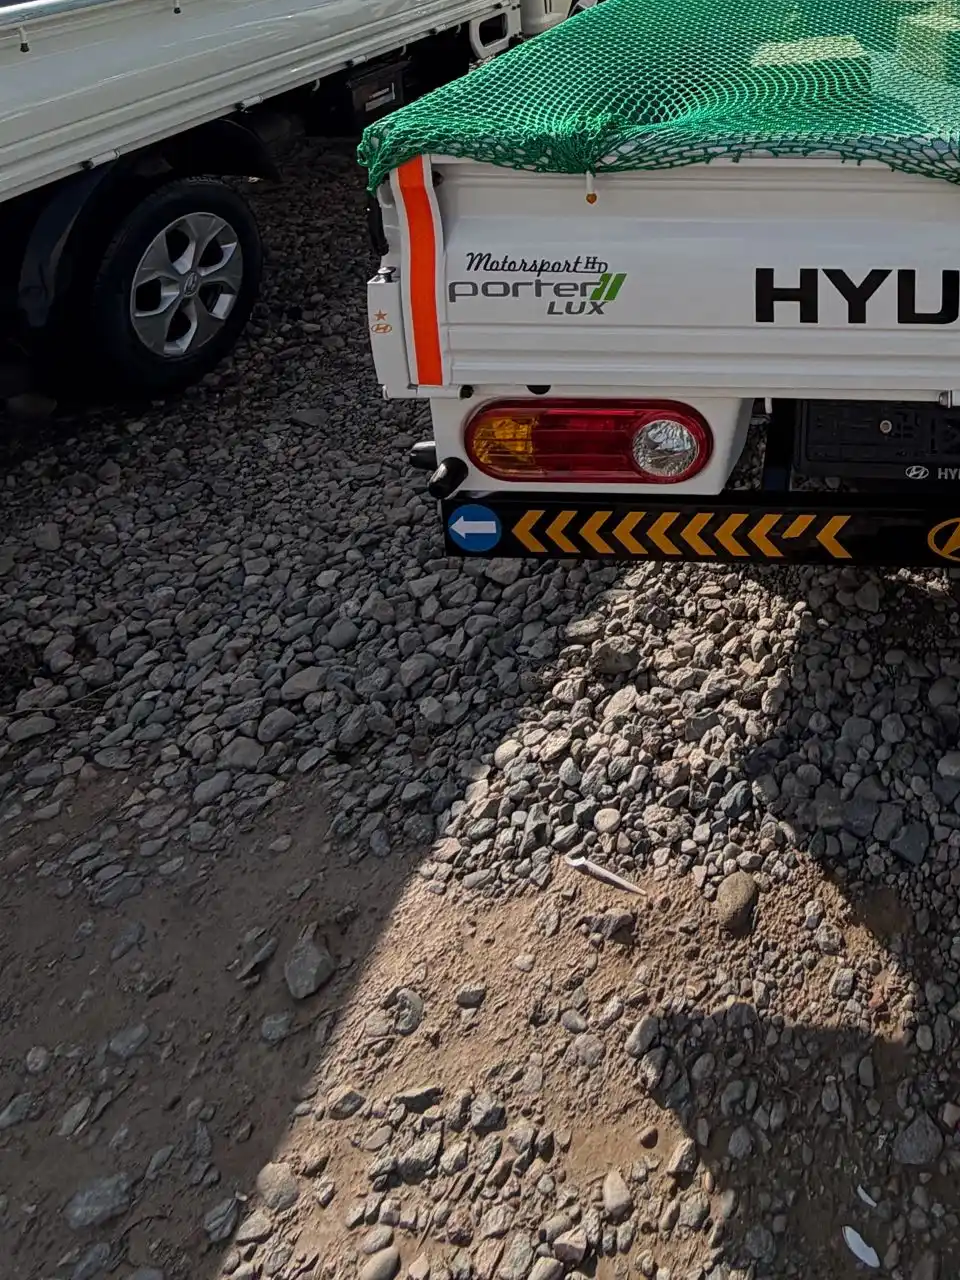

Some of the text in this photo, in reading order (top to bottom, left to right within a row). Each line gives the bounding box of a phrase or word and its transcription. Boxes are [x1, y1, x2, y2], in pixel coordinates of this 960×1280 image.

[466, 252, 609, 277] Motorsport HD
[547, 301, 609, 315] LUX
